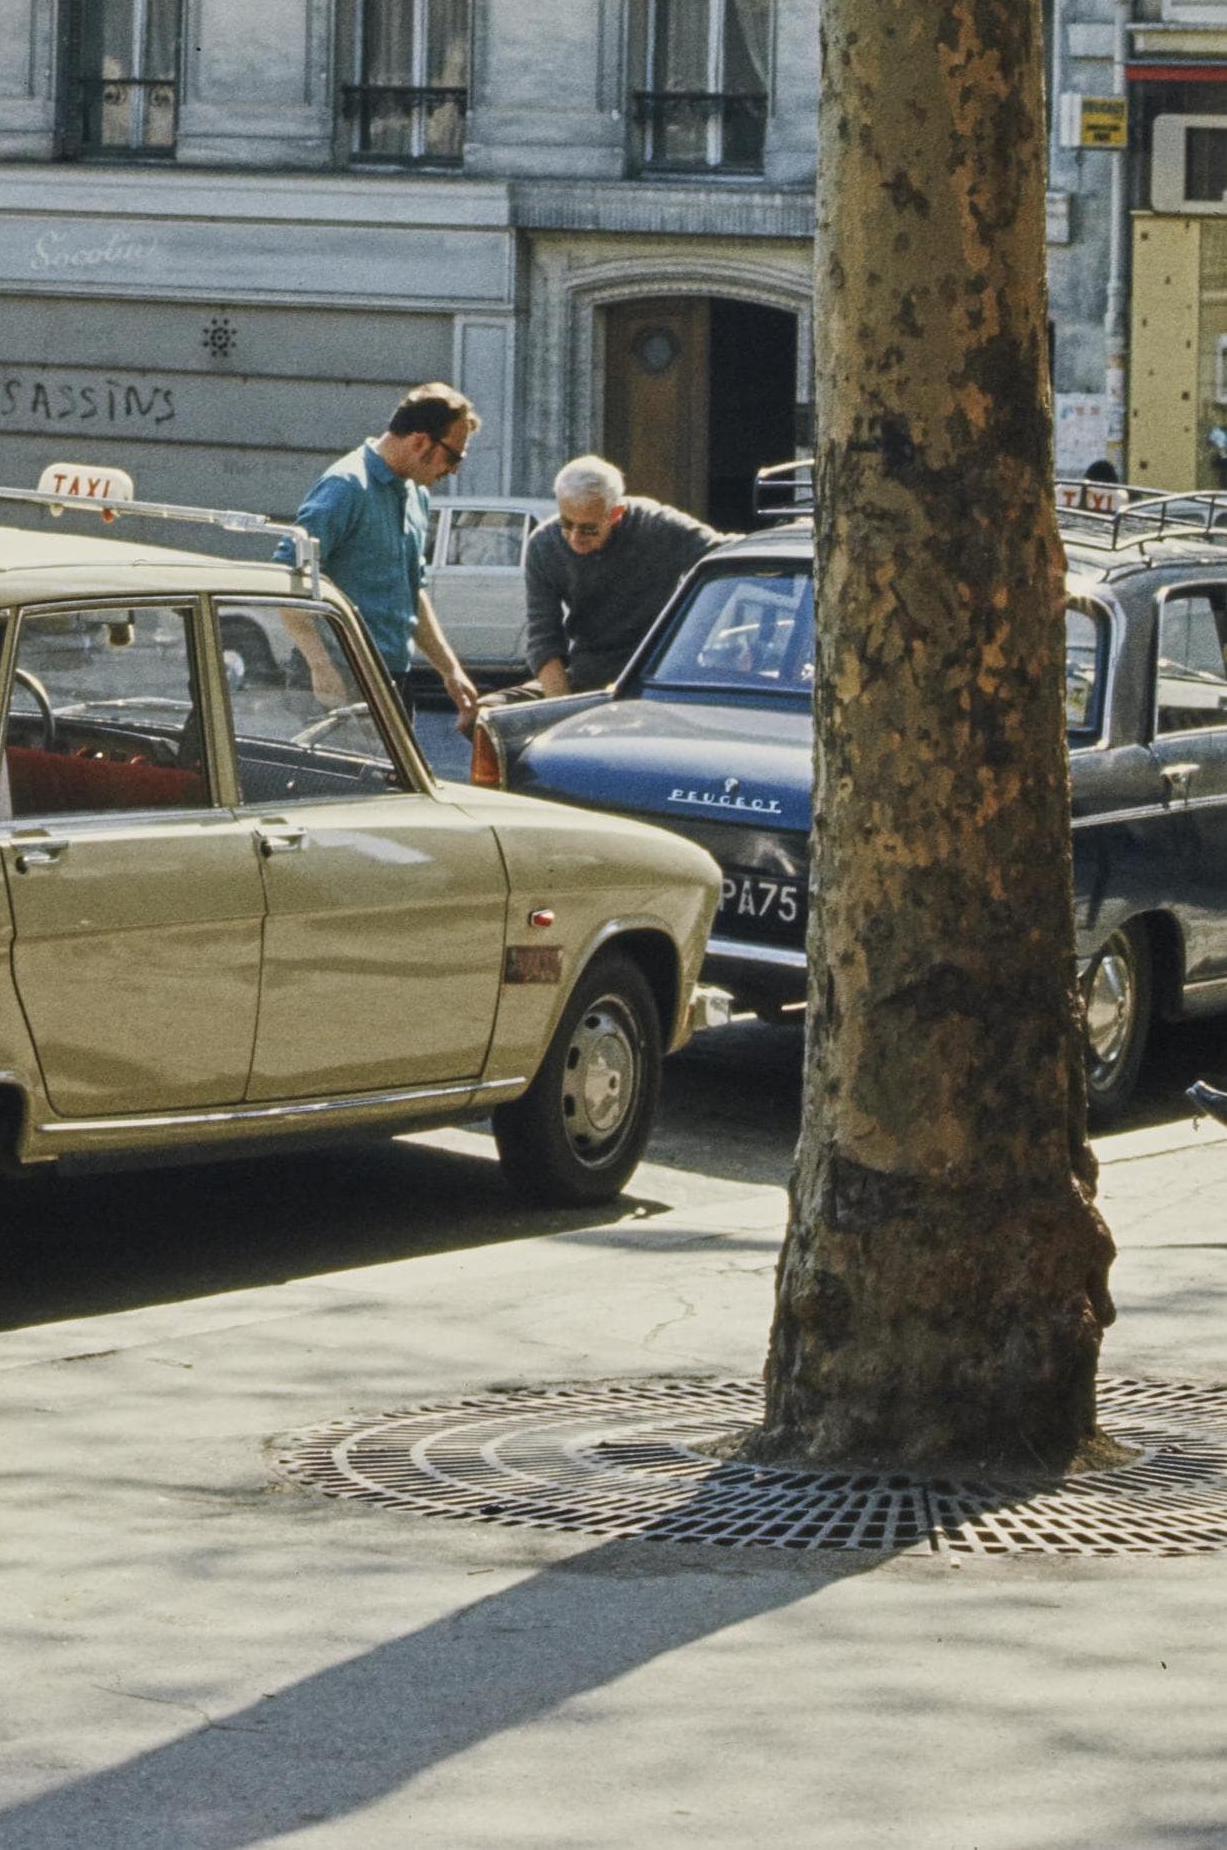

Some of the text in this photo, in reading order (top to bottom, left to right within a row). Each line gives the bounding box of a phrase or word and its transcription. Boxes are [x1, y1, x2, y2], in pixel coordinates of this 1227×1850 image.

[53, 473, 111, 499] TAXI
[1062, 490, 1113, 510] TXI
[670, 788, 781, 813] PEUGEOT
